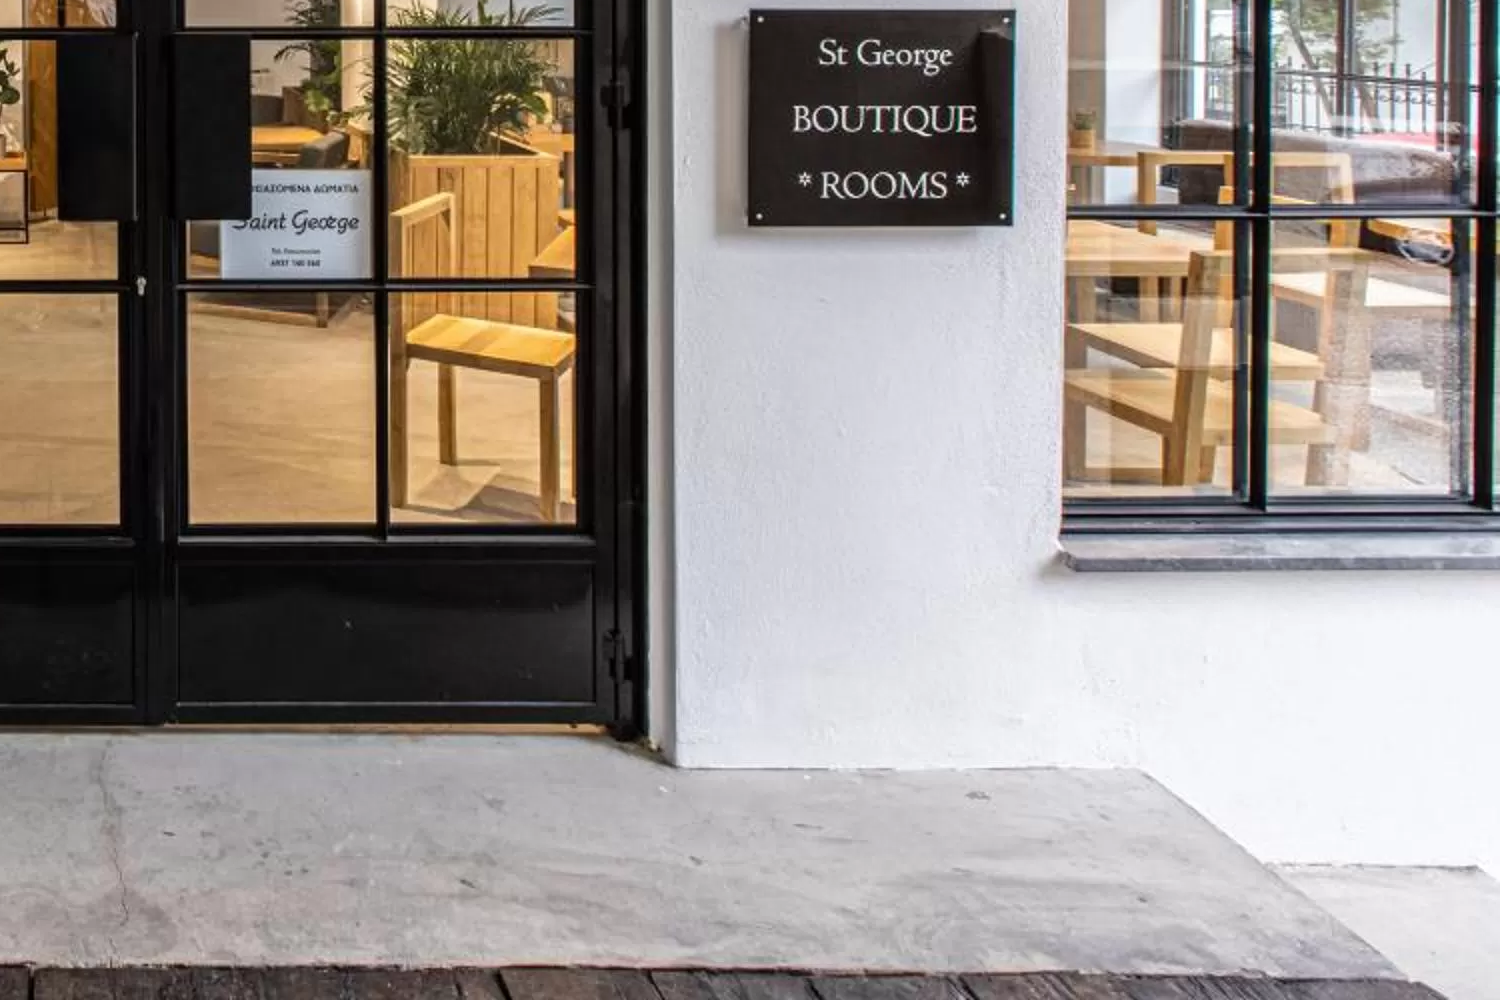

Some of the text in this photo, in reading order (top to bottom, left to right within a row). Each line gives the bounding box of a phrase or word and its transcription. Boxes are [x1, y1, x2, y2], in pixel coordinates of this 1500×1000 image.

[819, 38, 953, 77] St George
[793, 104, 977, 137] BOUTIQUE
[820, 171, 948, 199] ROOMS
[291, 209, 360, 236] George
